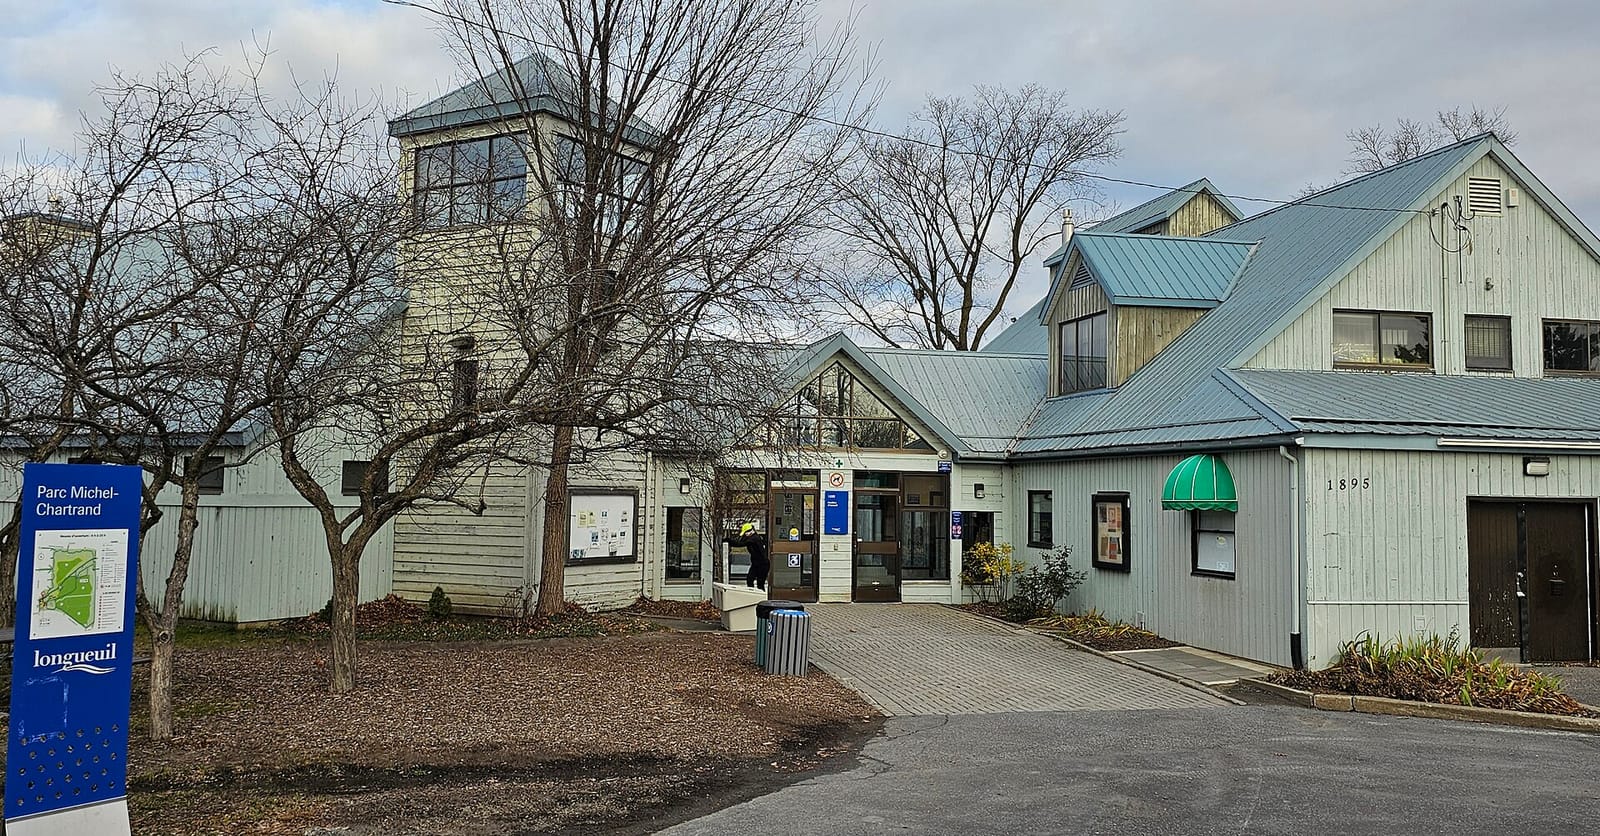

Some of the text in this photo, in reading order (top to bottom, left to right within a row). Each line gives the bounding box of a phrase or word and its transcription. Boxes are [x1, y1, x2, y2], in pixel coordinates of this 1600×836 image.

[1327, 477, 1370, 491] 1895
[37, 485, 119, 499] Parc Michel-
[36, 503, 102, 516] Chartrand
[32, 642, 117, 671] longueuil
